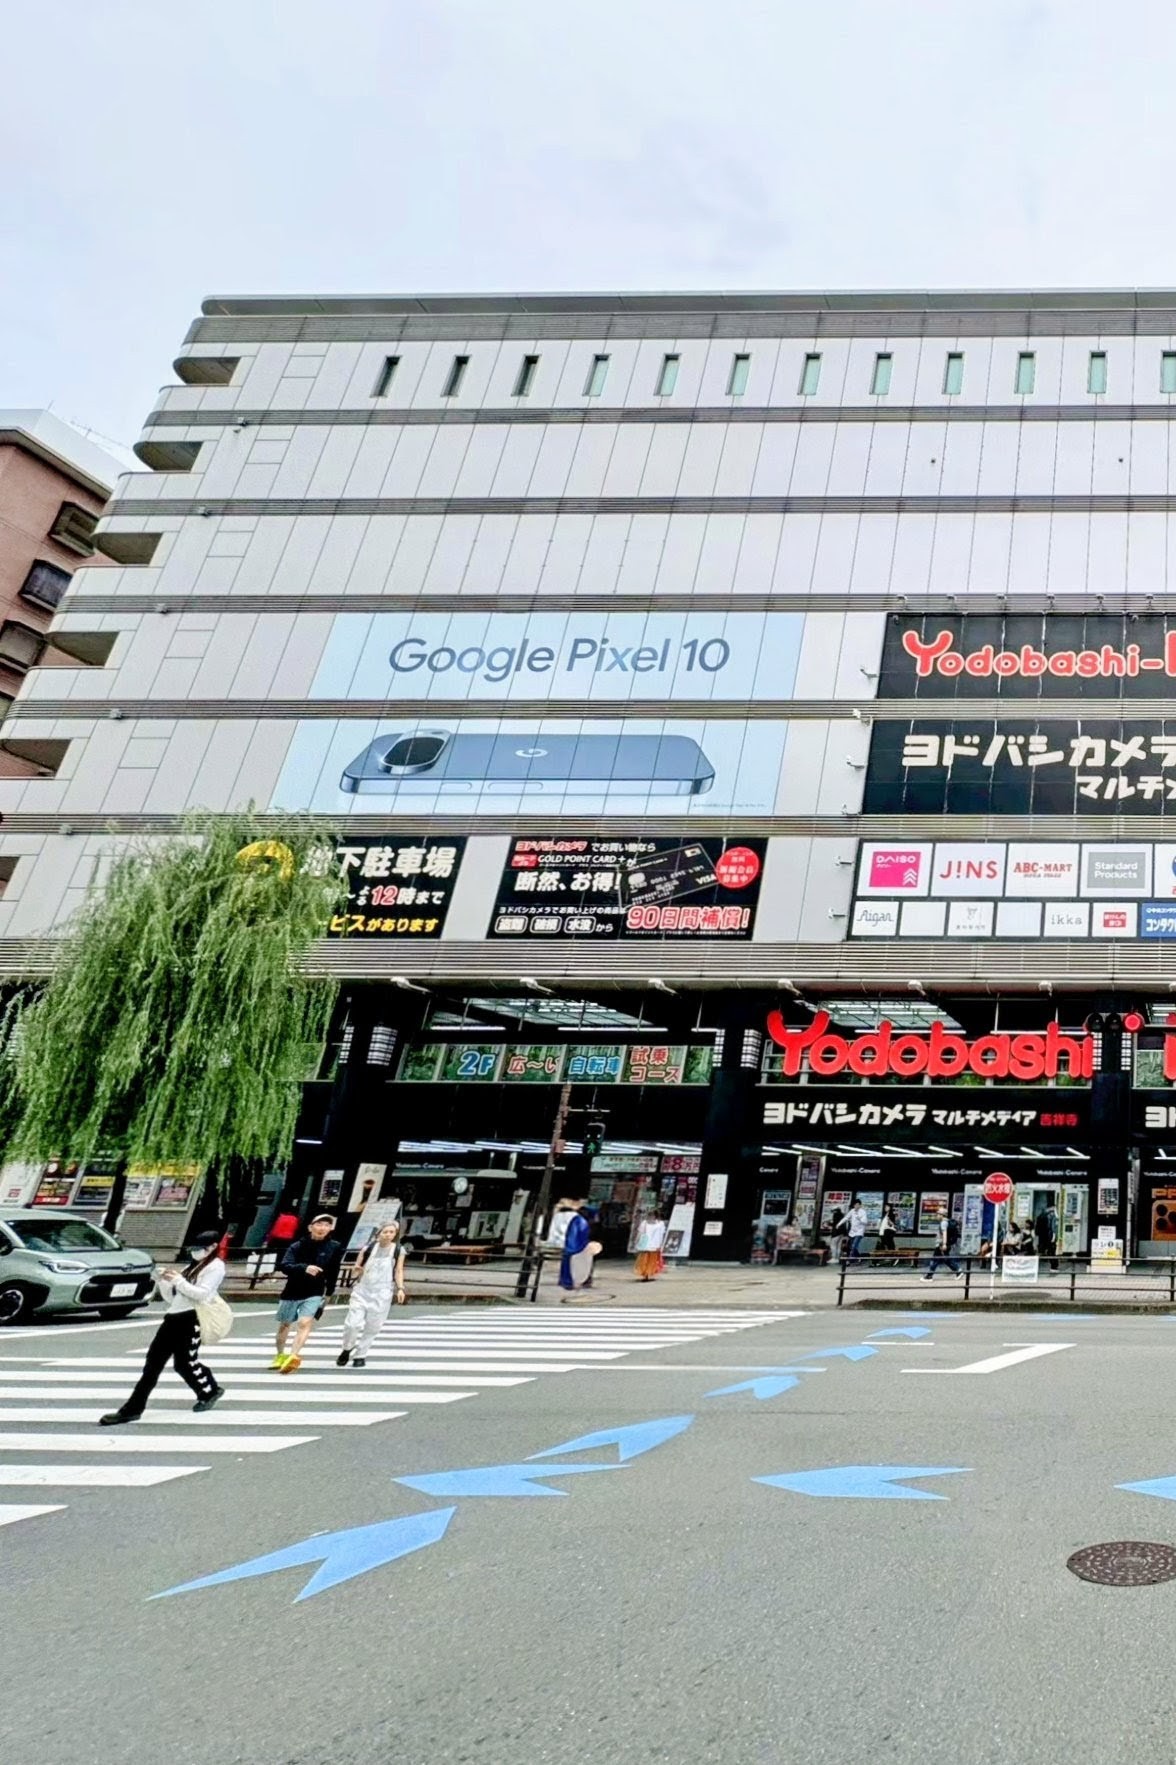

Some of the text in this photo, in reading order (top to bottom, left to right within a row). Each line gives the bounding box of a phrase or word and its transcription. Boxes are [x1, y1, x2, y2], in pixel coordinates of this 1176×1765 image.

[389, 638, 730, 682] Google Pixel 10
[538, 855, 562, 863] GOLD
[564, 855, 592, 863] POINT
[592, 855, 617, 864] CARD
[876, 855, 916, 864] DAISO
[1014, 862, 1072, 873] ABC-MART
[1094, 862, 1138, 870] Standard
[696, 874, 717, 885] VISA
[767, 1009, 1094, 1080] Yodobashi
[457, 1051, 496, 1076] 2F
[630, 1047, 668, 1065] 試乗
[568, 1056, 620, 1075] 自転車
[630, 1067, 681, 1082] コース
[763, 1103, 927, 1126] ヨドバシカメラ
[931, 1109, 1037, 1127] マルチメディア
